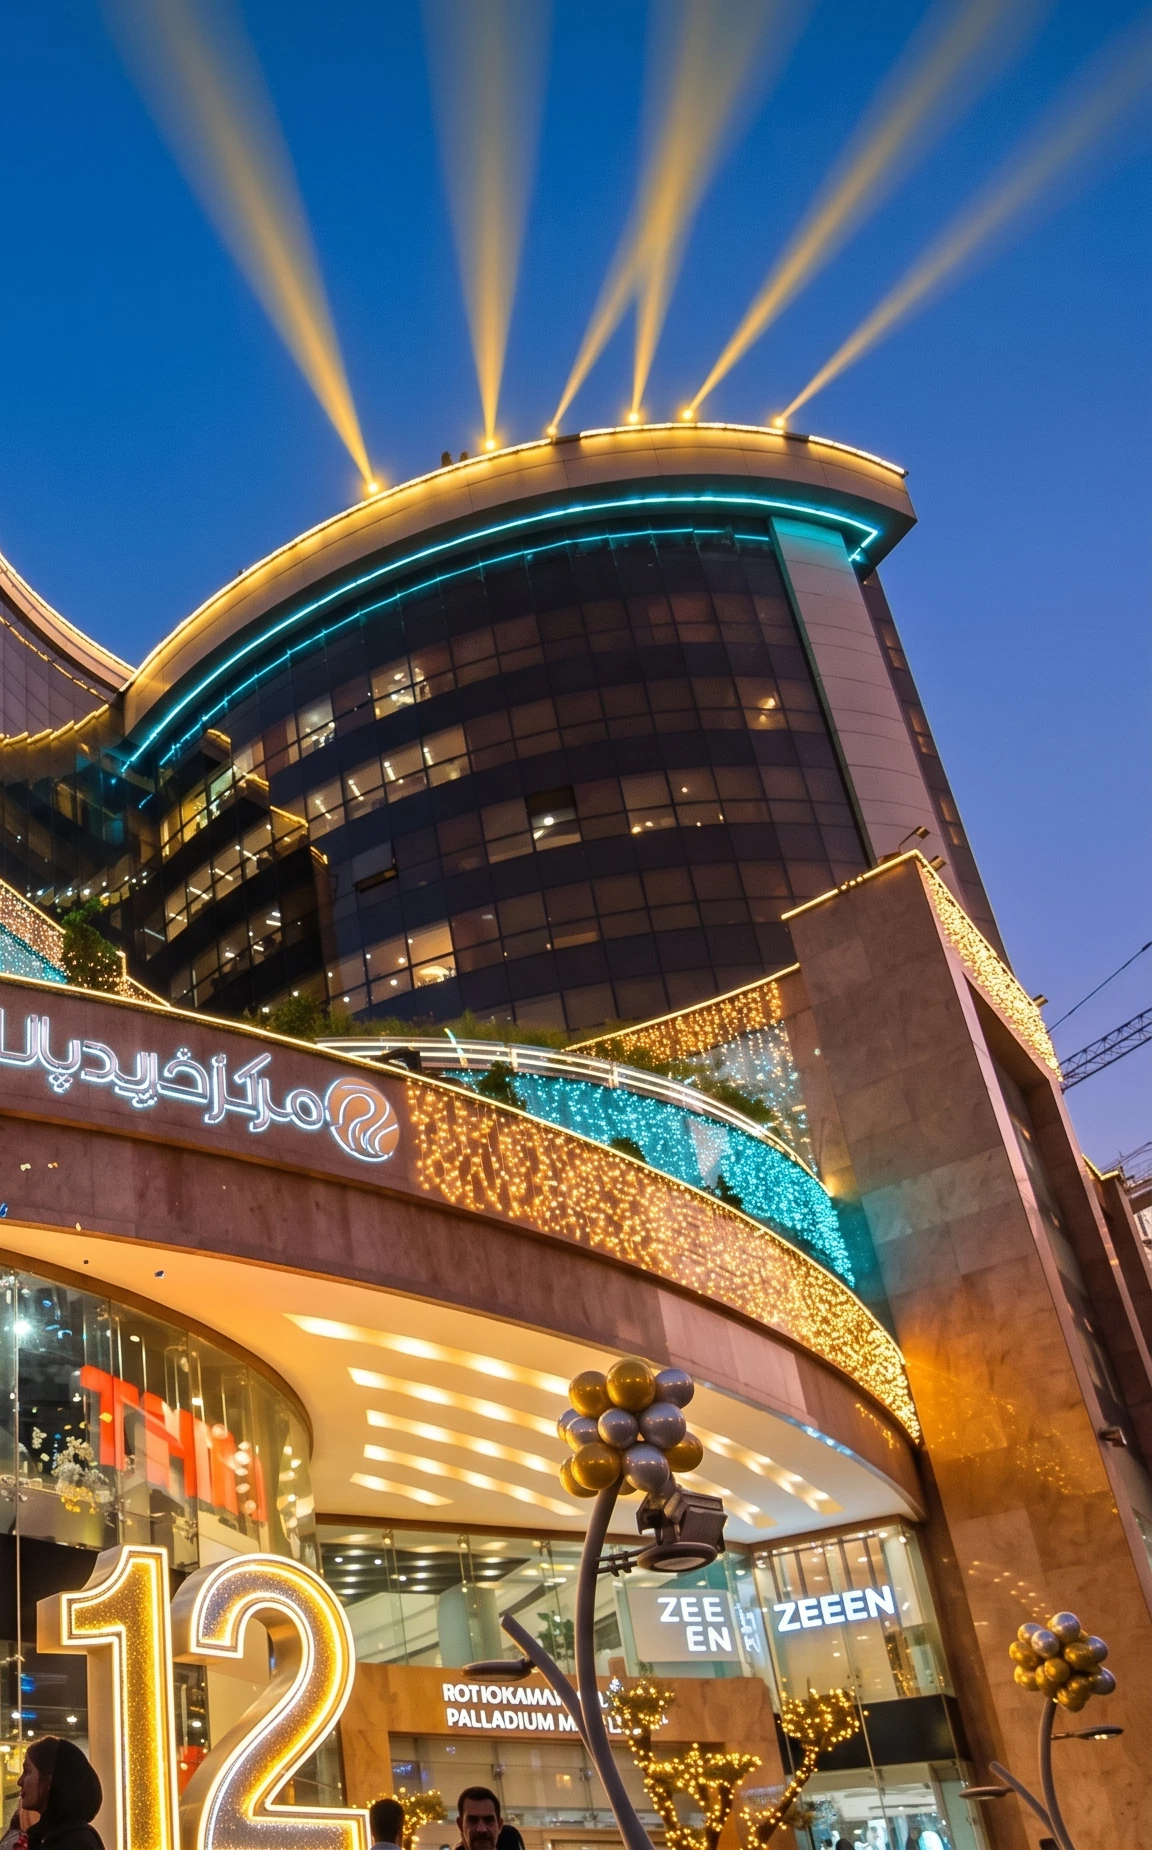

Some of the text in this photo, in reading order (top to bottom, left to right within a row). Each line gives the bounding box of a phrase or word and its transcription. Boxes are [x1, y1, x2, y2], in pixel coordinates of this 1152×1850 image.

[80, 1047, 210, 1108] خرید
[203, 1052, 324, 1132] مرکز
[657, 1596, 725, 1623] ZEE
[773, 1585, 896, 1632] ZEEEN
[685, 1626, 733, 1652] EN
[37, 1545, 371, 1850] 12
[446, 1708, 555, 1731] PALLADIUM
